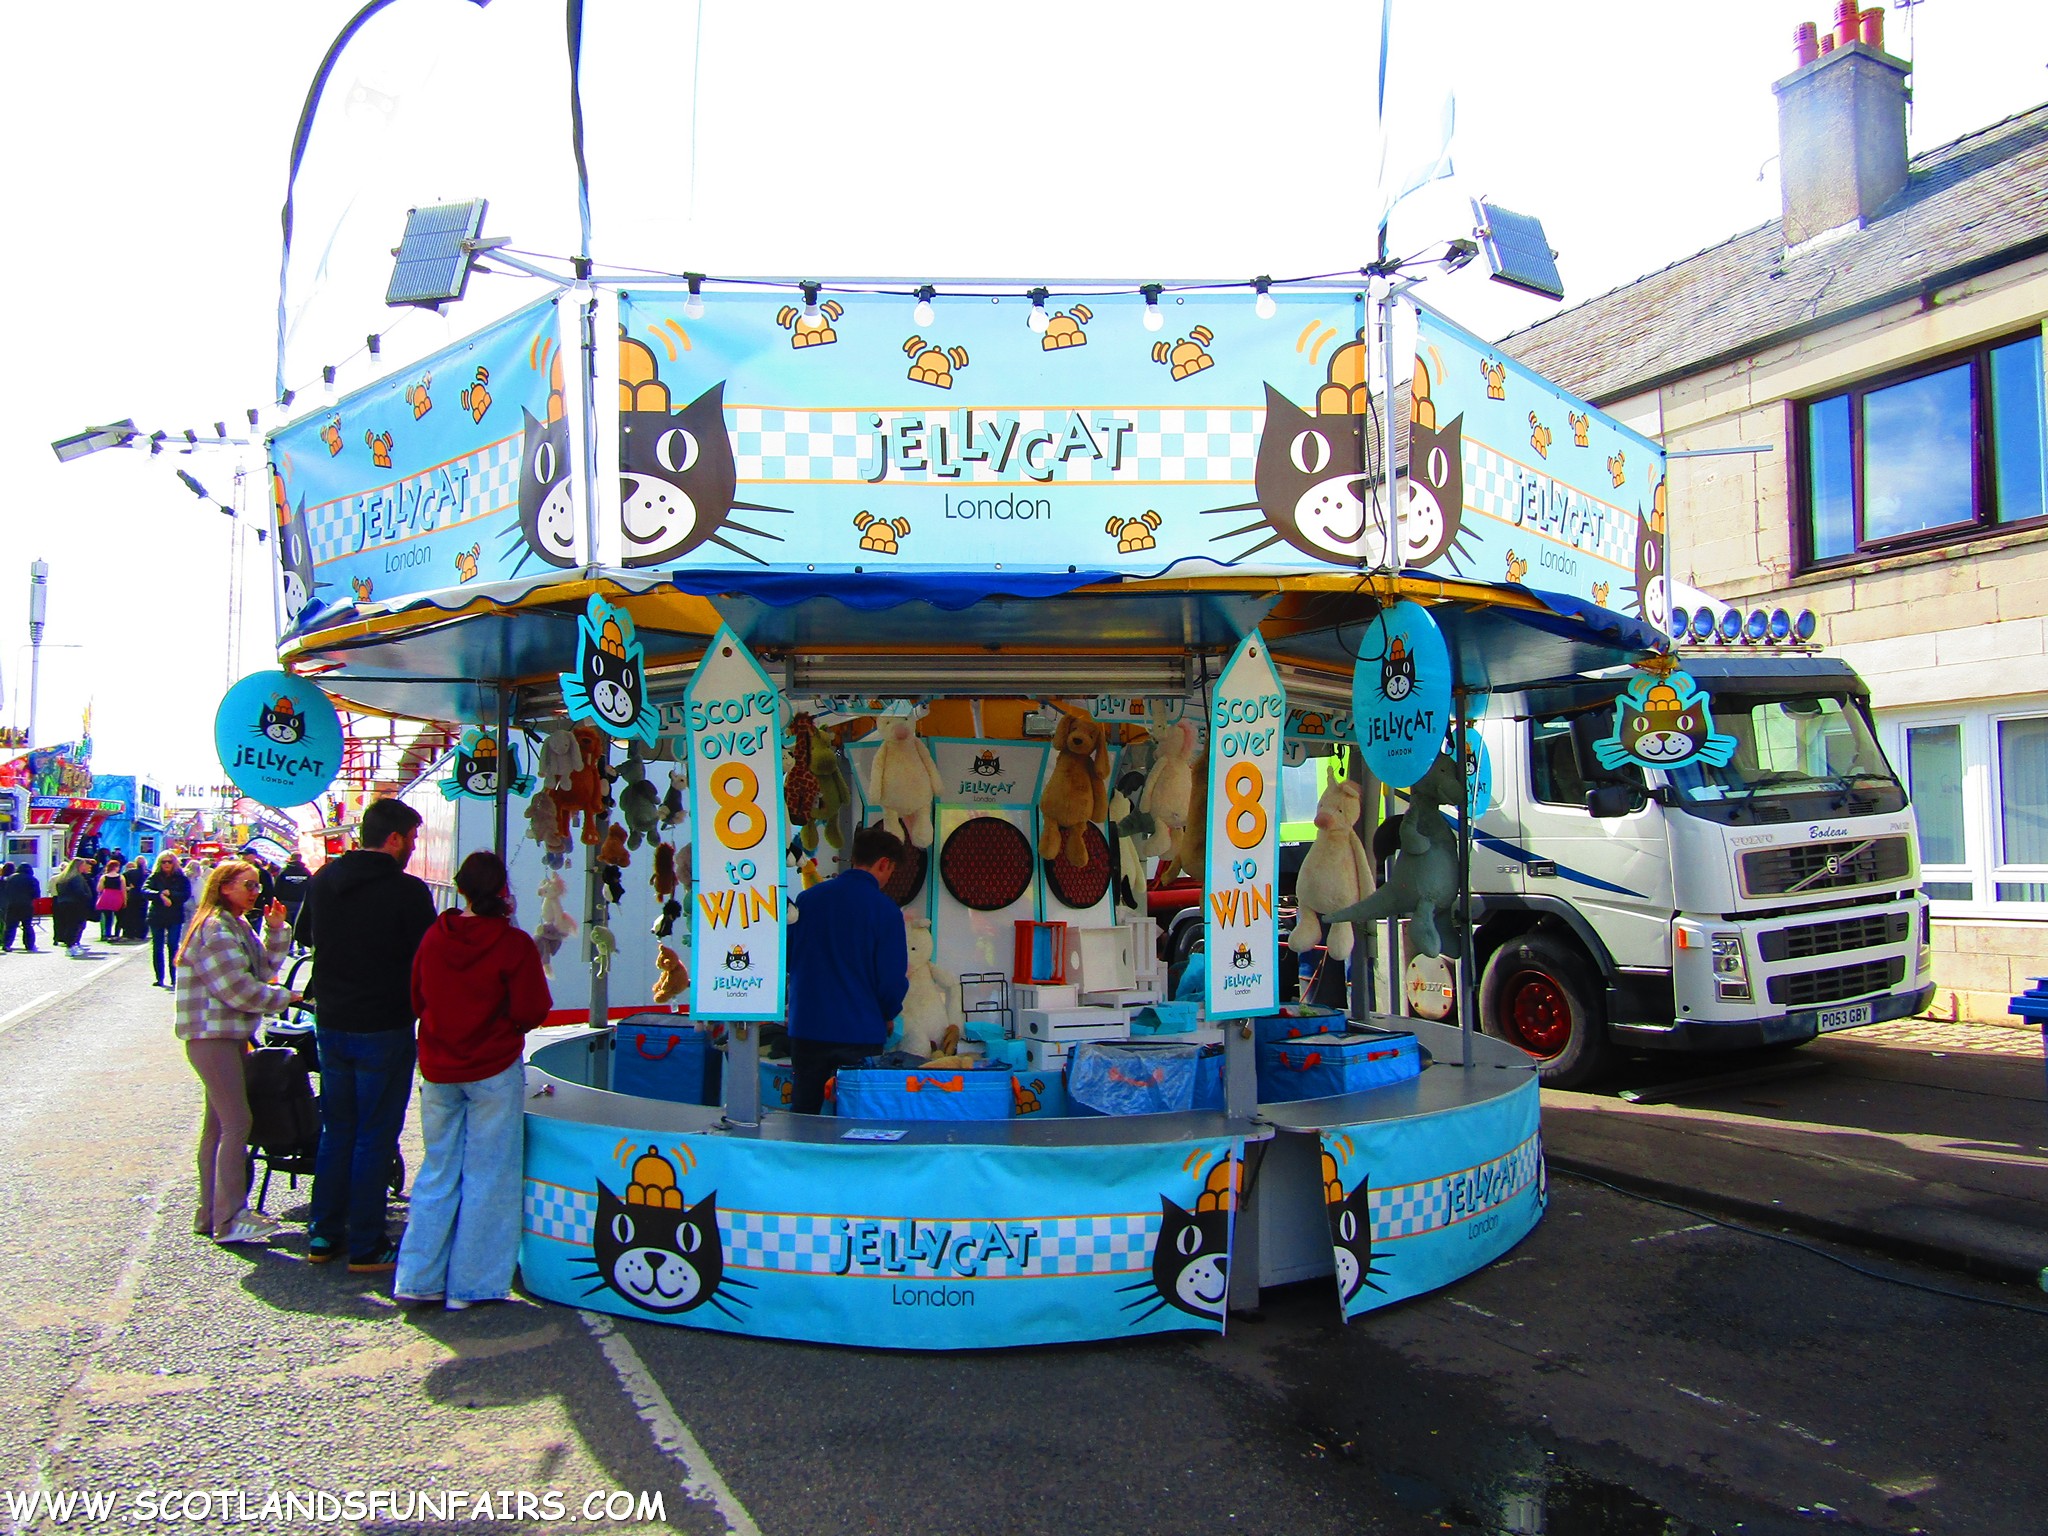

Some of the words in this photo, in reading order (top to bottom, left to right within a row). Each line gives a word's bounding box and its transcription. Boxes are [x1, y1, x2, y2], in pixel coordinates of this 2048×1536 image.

[945, 493, 1051, 520] London
[385, 544, 432, 574] London
[1540, 544, 1577, 577] London
[701, 725, 769, 759] over
[1221, 727, 1275, 757] over
[1387, 748, 1413, 757] LONDON
[210, 784, 242, 798] MOUS
[261, 776, 295, 786] LONDON
[709, 761, 768, 850] 8
[1225, 761, 1267, 849] 8
[1729, 833, 1775, 847] VOLVO
[1808, 825, 1849, 839] Bodean
[724, 858, 757, 885] to
[1232, 858, 1257, 884] to
[697, 884, 779, 930] WIN
[1209, 882, 1272, 930] WIN
[1234, 987, 1251, 996] London
[1822, 1011, 1847, 1027] PO53
[1849, 1007, 1868, 1022] GBY
[1468, 1214, 1499, 1239] London
[893, 1284, 974, 1307] London
